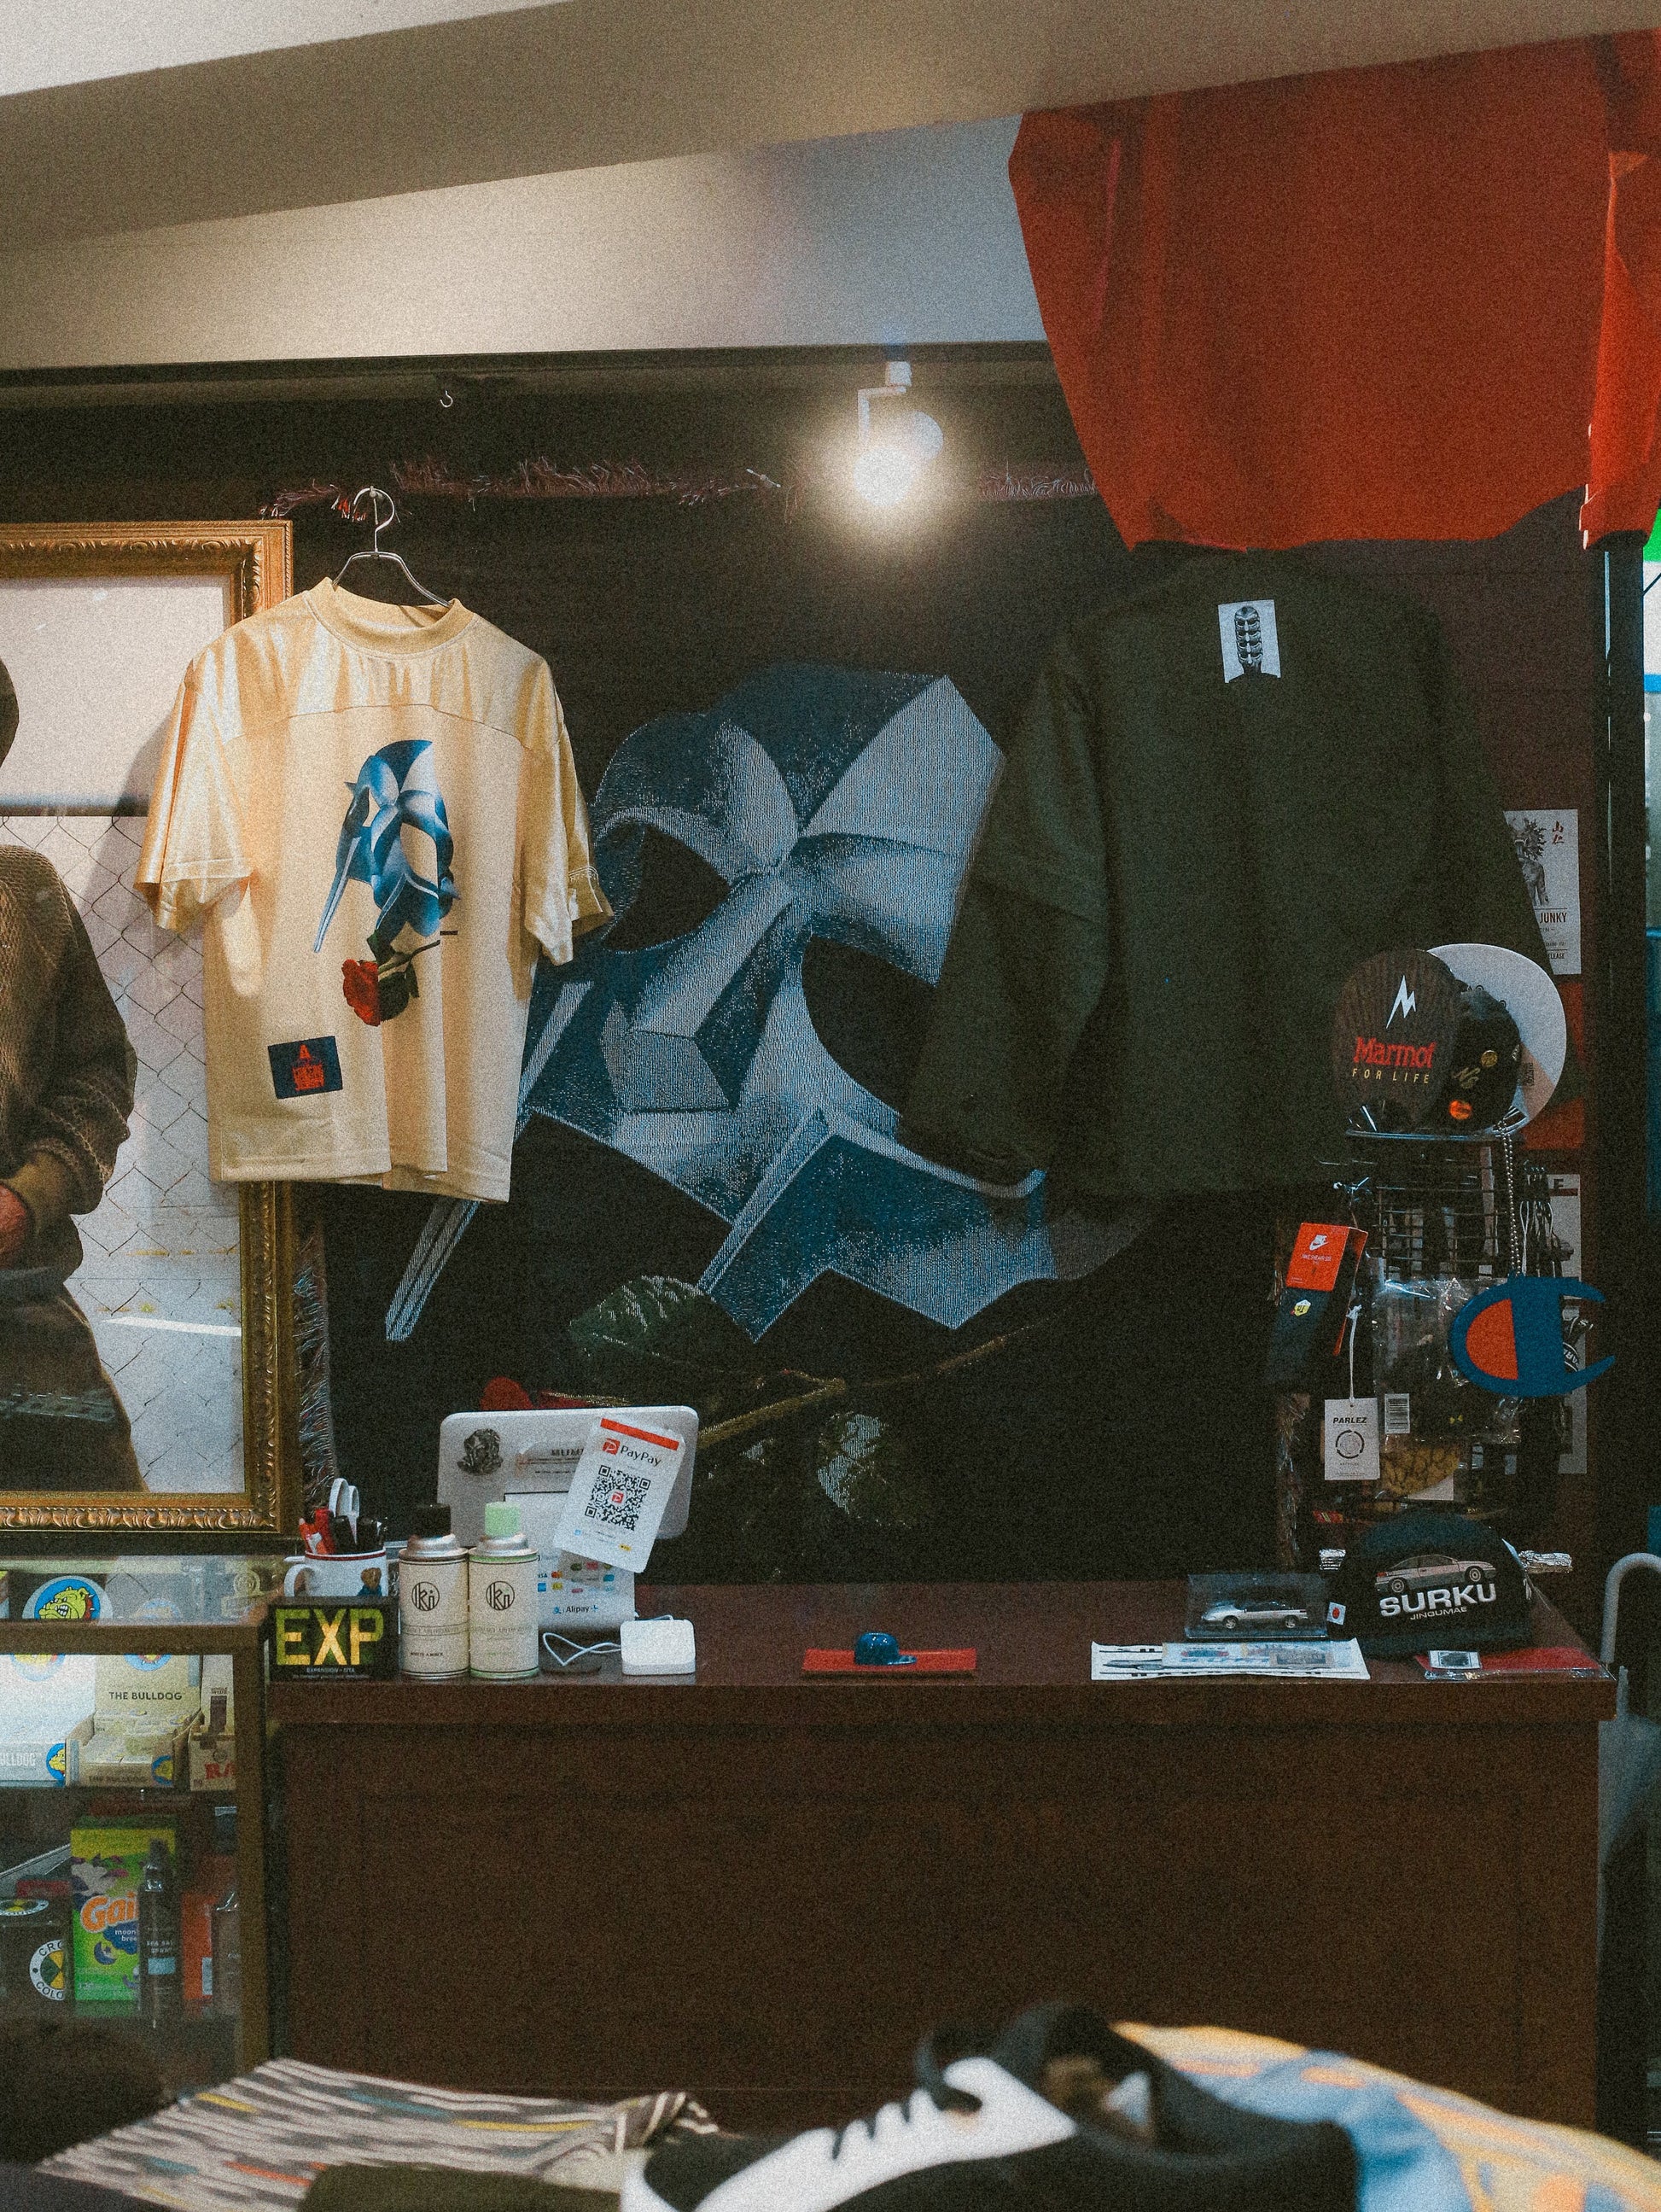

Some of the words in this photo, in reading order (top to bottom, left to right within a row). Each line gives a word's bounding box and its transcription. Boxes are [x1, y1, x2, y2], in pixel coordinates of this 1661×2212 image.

[1539, 912, 1567, 924] JUNKY
[1353, 1036, 1437, 1069] Marmot
[1352, 1067, 1383, 1081] FOR
[1392, 1071, 1431, 1084] LIFE
[620, 1445, 662, 1467] PayPay
[1378, 1583, 1497, 1618] SURKU
[1409, 1606, 1467, 1620] JINGUMAE
[276, 1608, 384, 1666] EXP
[108, 1691, 128, 1701] THE
[131, 1691, 183, 1701] BULLDOG
[36, 1981, 64, 1999] COLO
